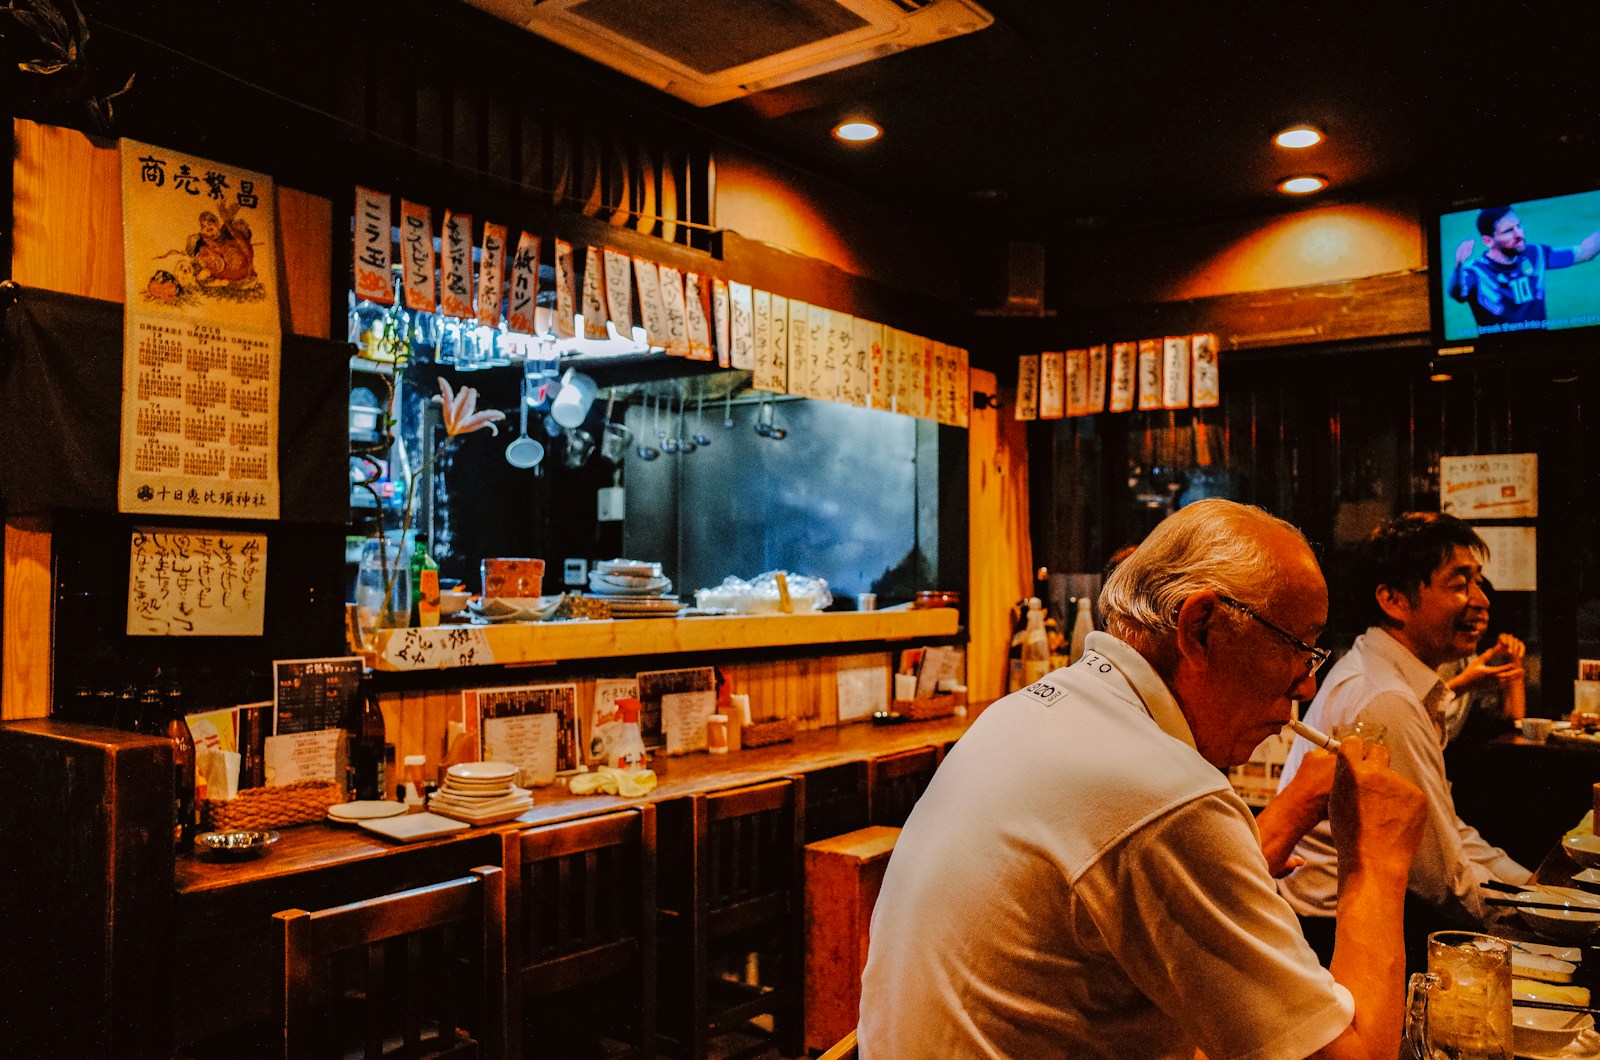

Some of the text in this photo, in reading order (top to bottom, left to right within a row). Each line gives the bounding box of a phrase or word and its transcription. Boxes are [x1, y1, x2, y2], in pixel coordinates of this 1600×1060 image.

[138, 155, 259, 209] 商売繁昌
[1510, 276, 1533, 304] 10
